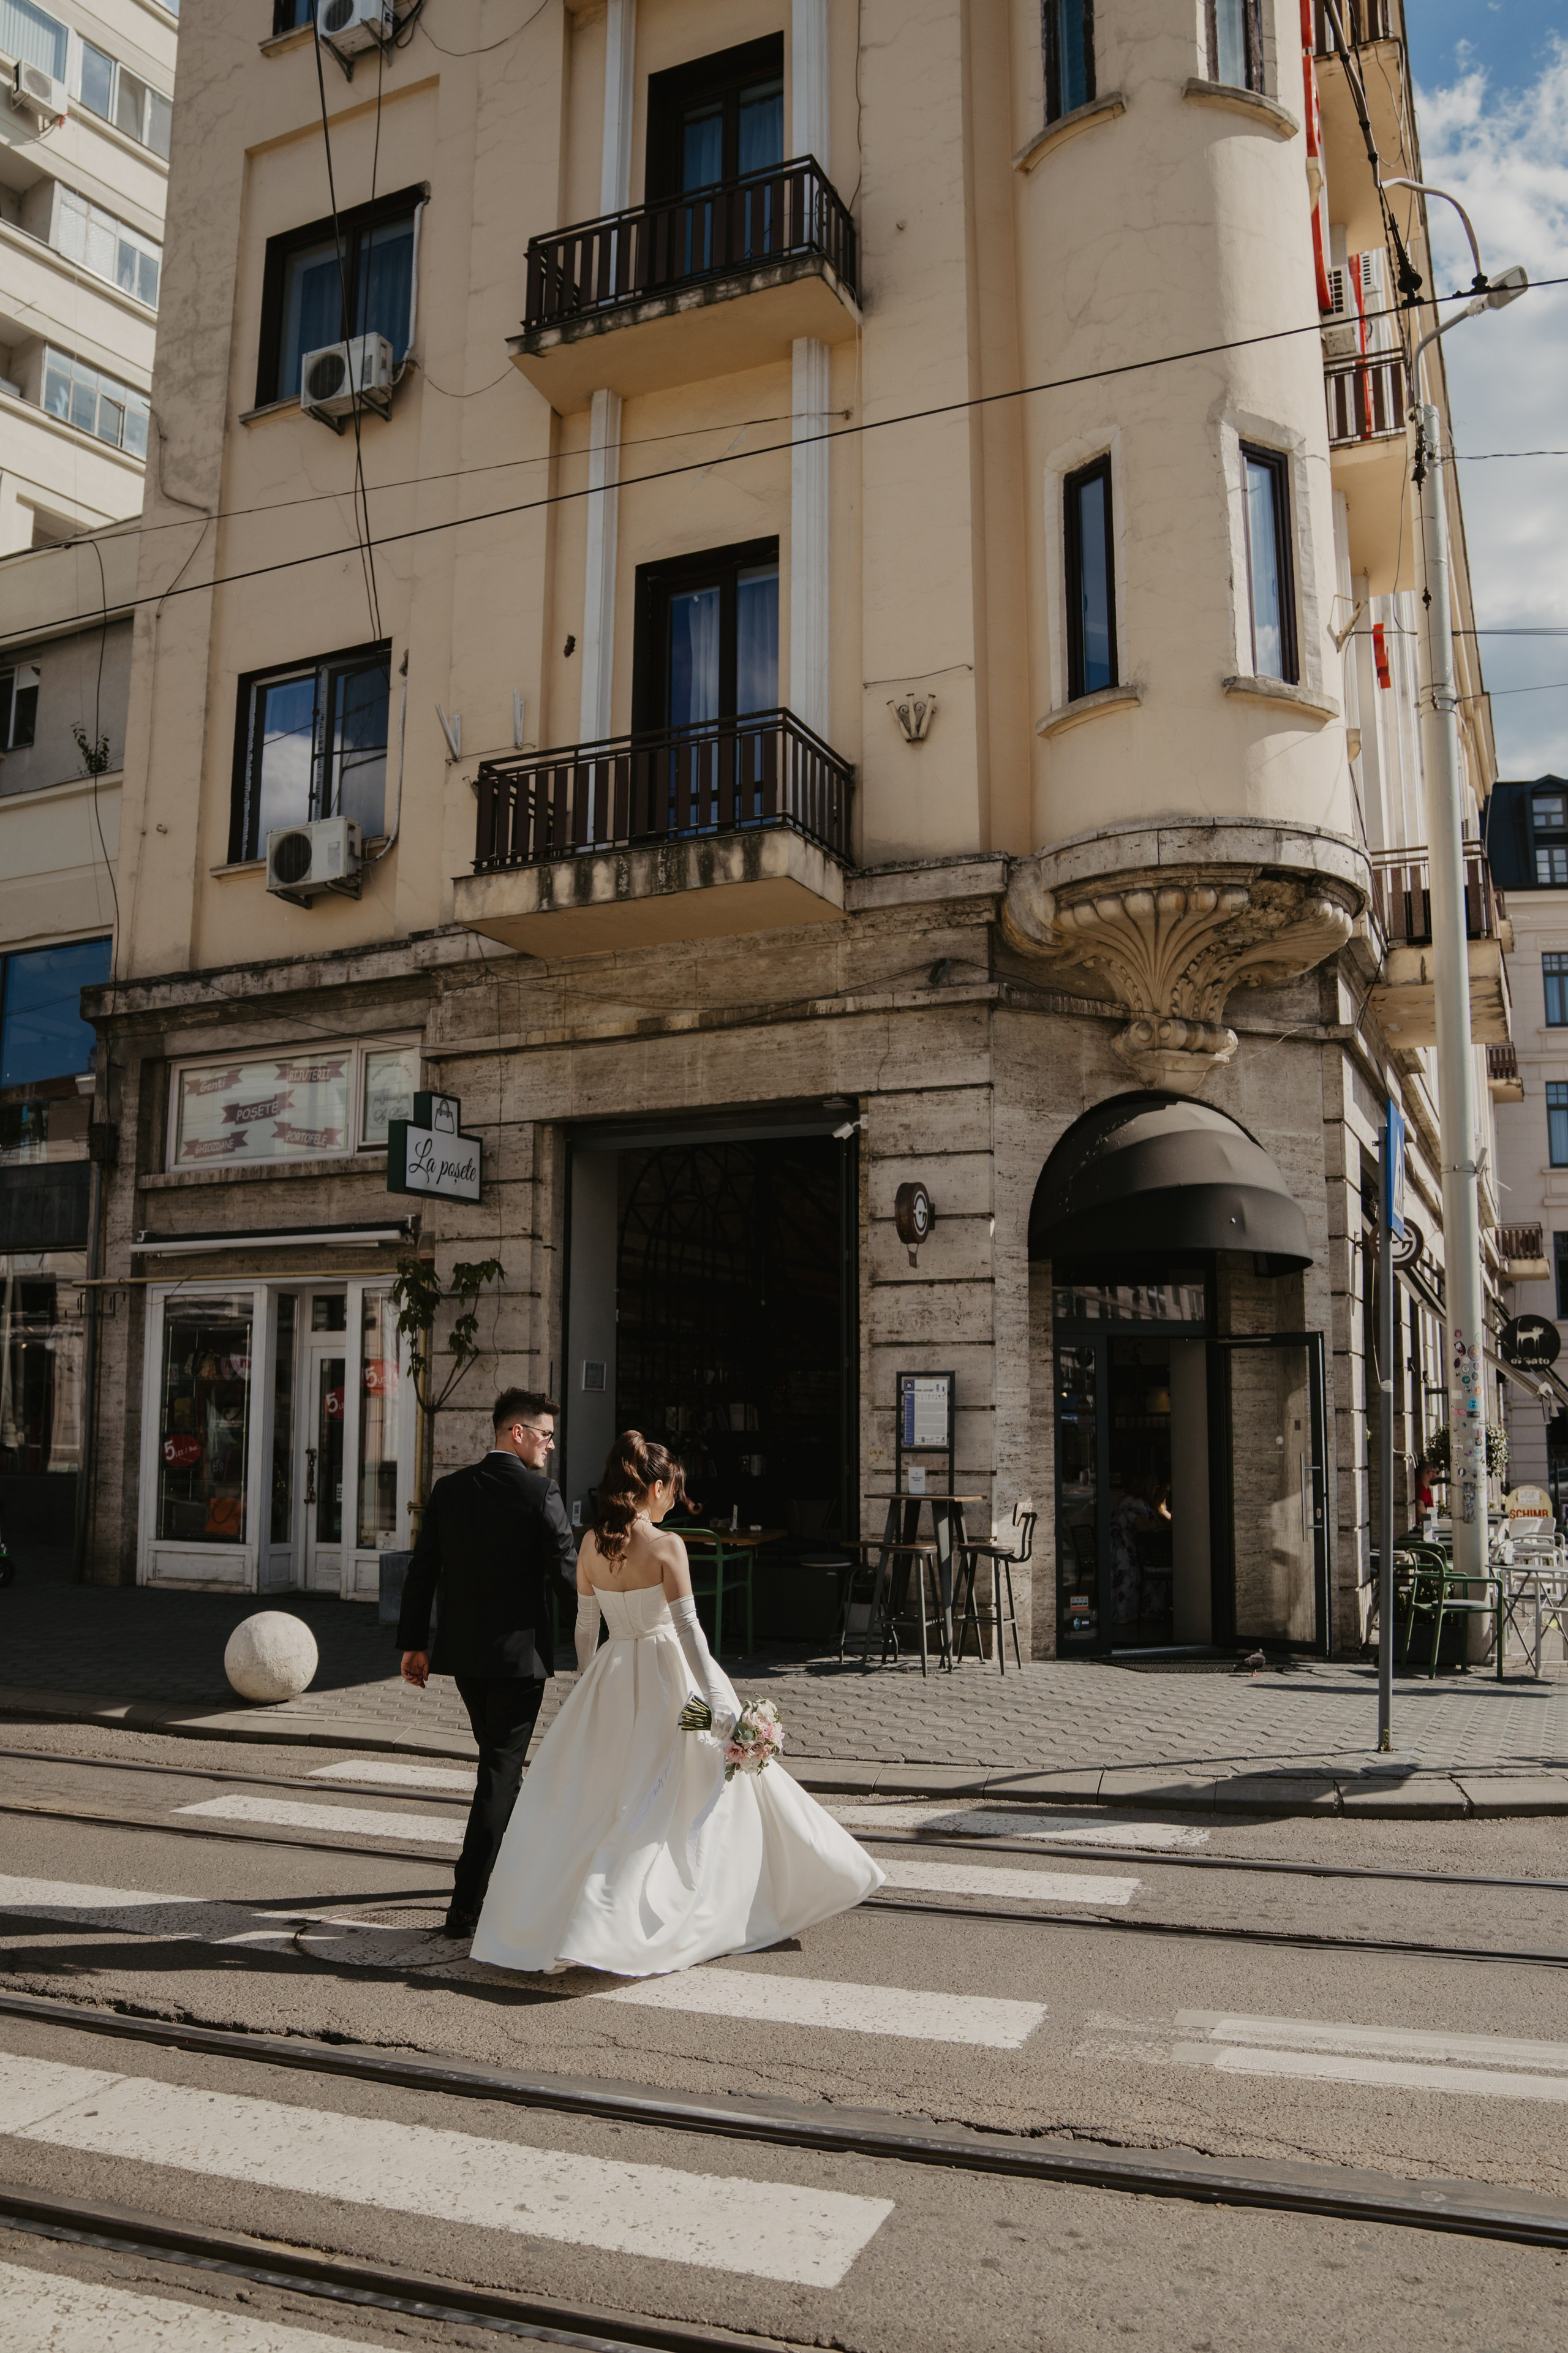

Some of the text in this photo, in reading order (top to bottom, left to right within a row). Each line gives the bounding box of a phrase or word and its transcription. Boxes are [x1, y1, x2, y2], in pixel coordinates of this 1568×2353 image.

[288, 1069, 331, 1081] BIJUTERII
[236, 1101, 278, 1121] POȘETE
[195, 1138, 234, 1154] GHIOZDANE
[285, 1131, 328, 1146] PORTOFELE
[409, 1138, 477, 1185] La poșete
[364, 1366, 377, 1388] 5
[325, 1392, 339, 1413] 5
[164, 1440, 175, 1460] 5
